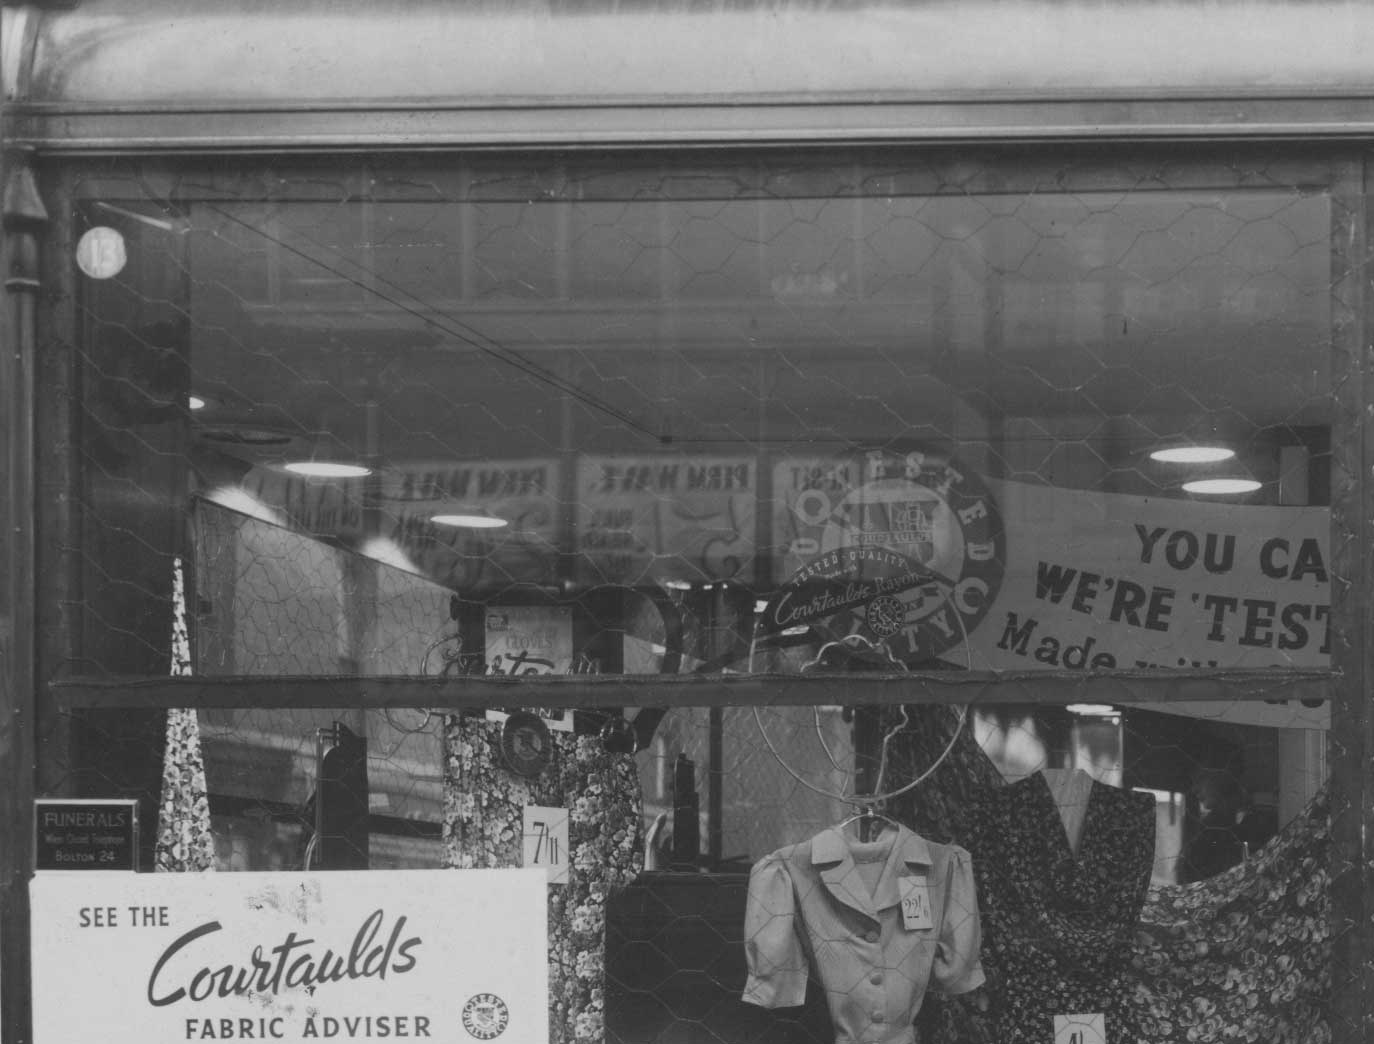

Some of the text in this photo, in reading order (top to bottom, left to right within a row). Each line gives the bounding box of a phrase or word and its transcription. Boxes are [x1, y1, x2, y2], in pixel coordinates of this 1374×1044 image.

[1134, 523, 1236, 575] YOU
[1259, 536, 1330, 583] CA
[774, 573, 921, 625] Courtaulds Rayon
[1035, 560, 1176, 632] WE'RE
[44, 811, 126, 828] FUNERALS
[98, 849, 117, 863] 24
[78, 906, 170, 928] SEE THE
[147, 908, 423, 1007] Courtaulds
[185, 1015, 432, 1040] FABRIC ADVISER
